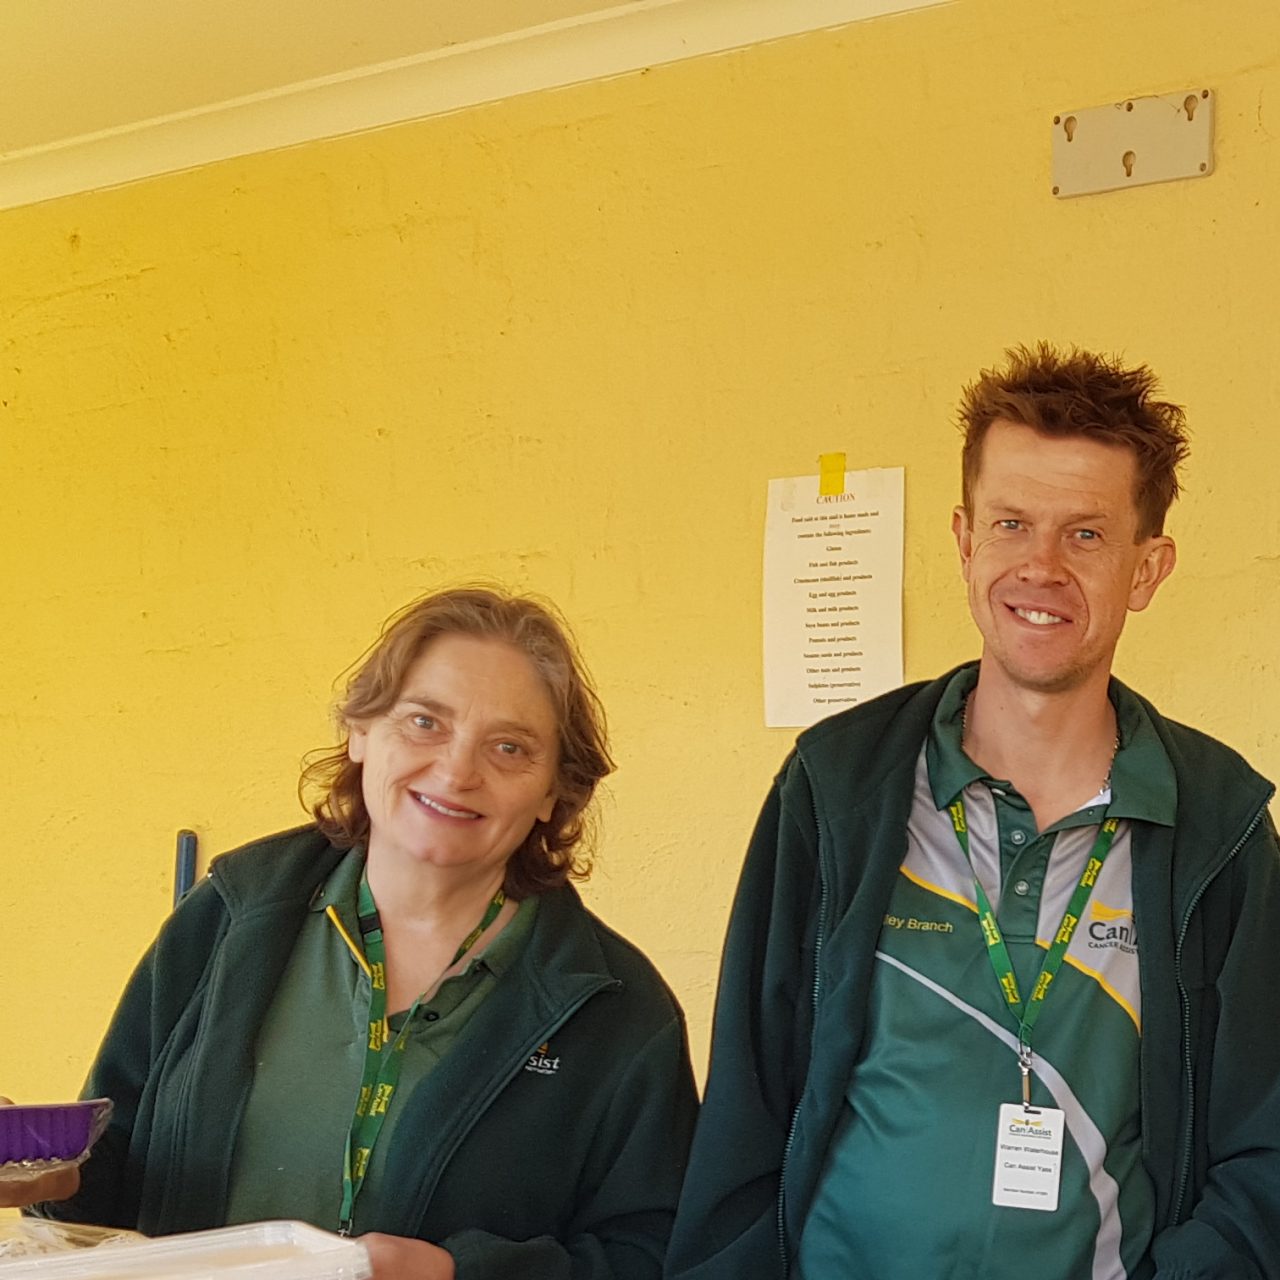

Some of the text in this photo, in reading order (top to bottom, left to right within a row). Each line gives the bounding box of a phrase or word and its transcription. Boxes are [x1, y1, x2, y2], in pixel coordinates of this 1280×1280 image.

[907, 918, 953, 933] Branch
[1089, 921, 1129, 943] Can
[1009, 1124, 1025, 1133] Can
[1028, 1127, 1052, 1137] Assist
